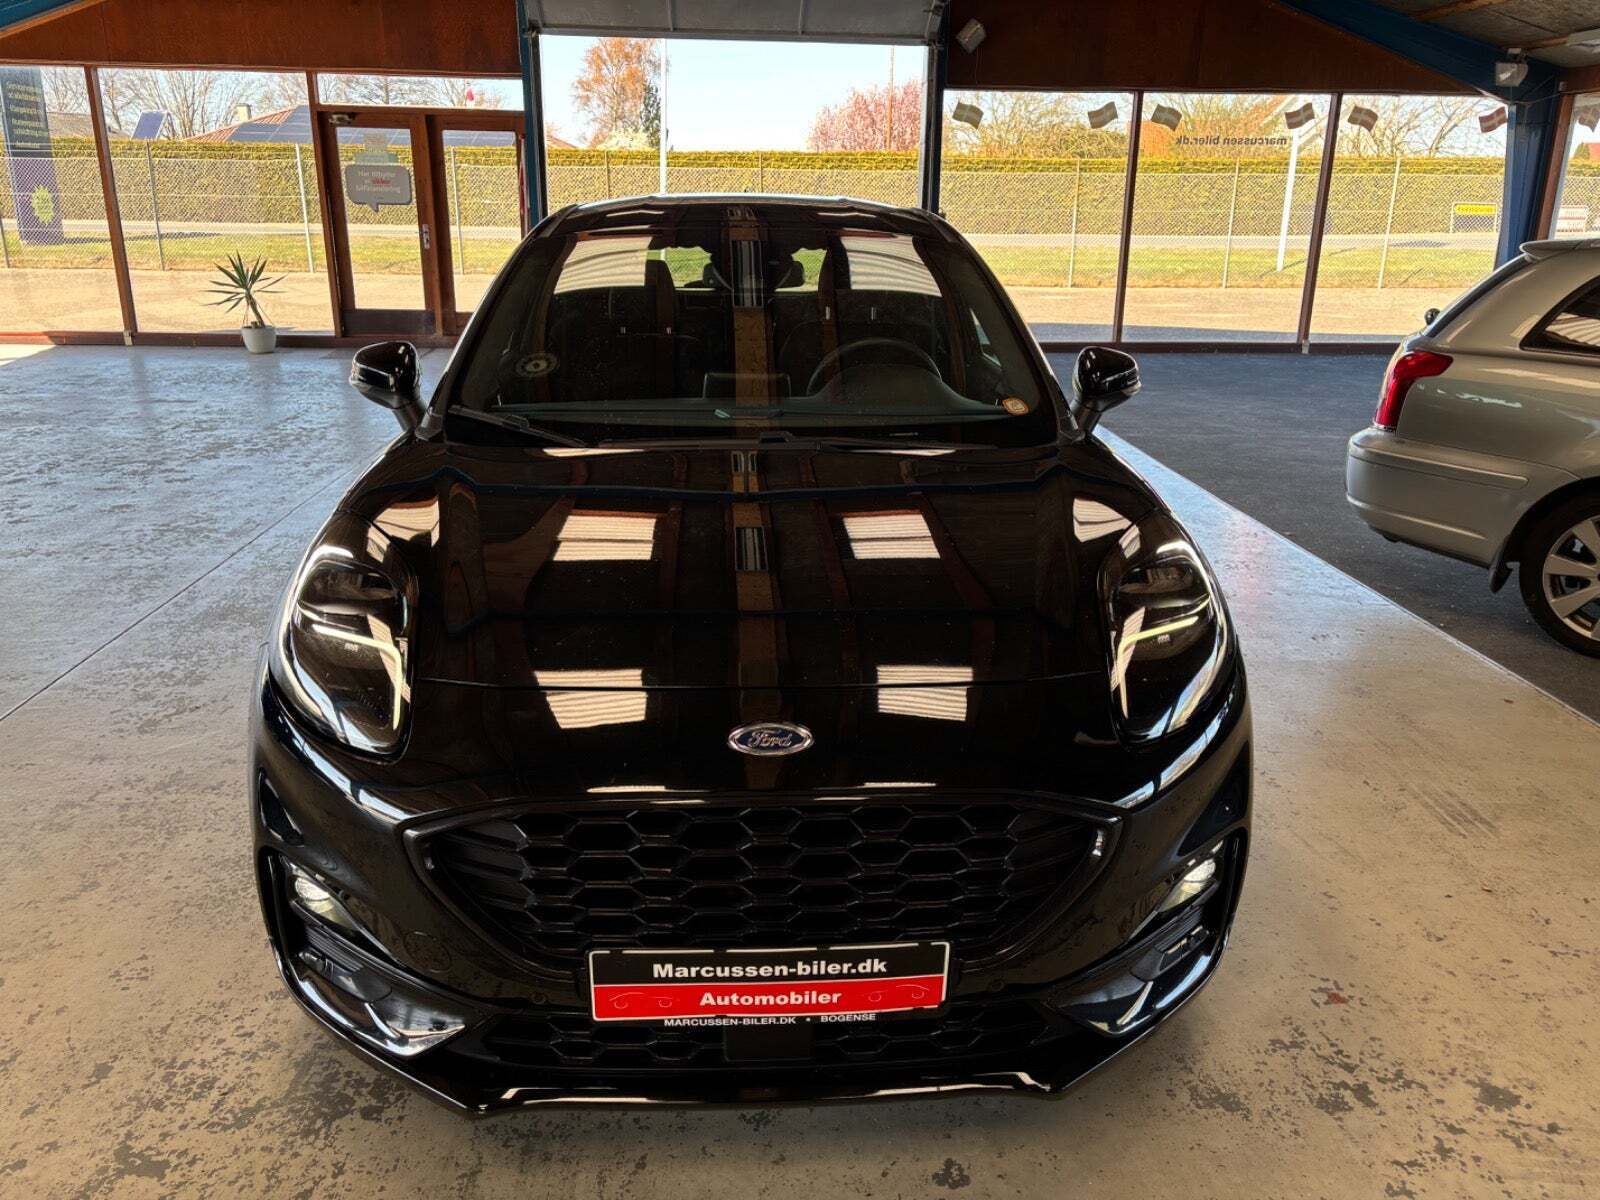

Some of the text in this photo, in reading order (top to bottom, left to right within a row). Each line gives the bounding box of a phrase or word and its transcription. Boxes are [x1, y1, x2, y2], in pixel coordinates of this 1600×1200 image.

[747, 729, 793, 748] Ford
[652, 959, 887, 978] Marcussen-biler.dk
[699, 990, 842, 1006] Automobiler
[663, 1013, 876, 1027] MARCUSSEN-BILER.DK BOGENSE
